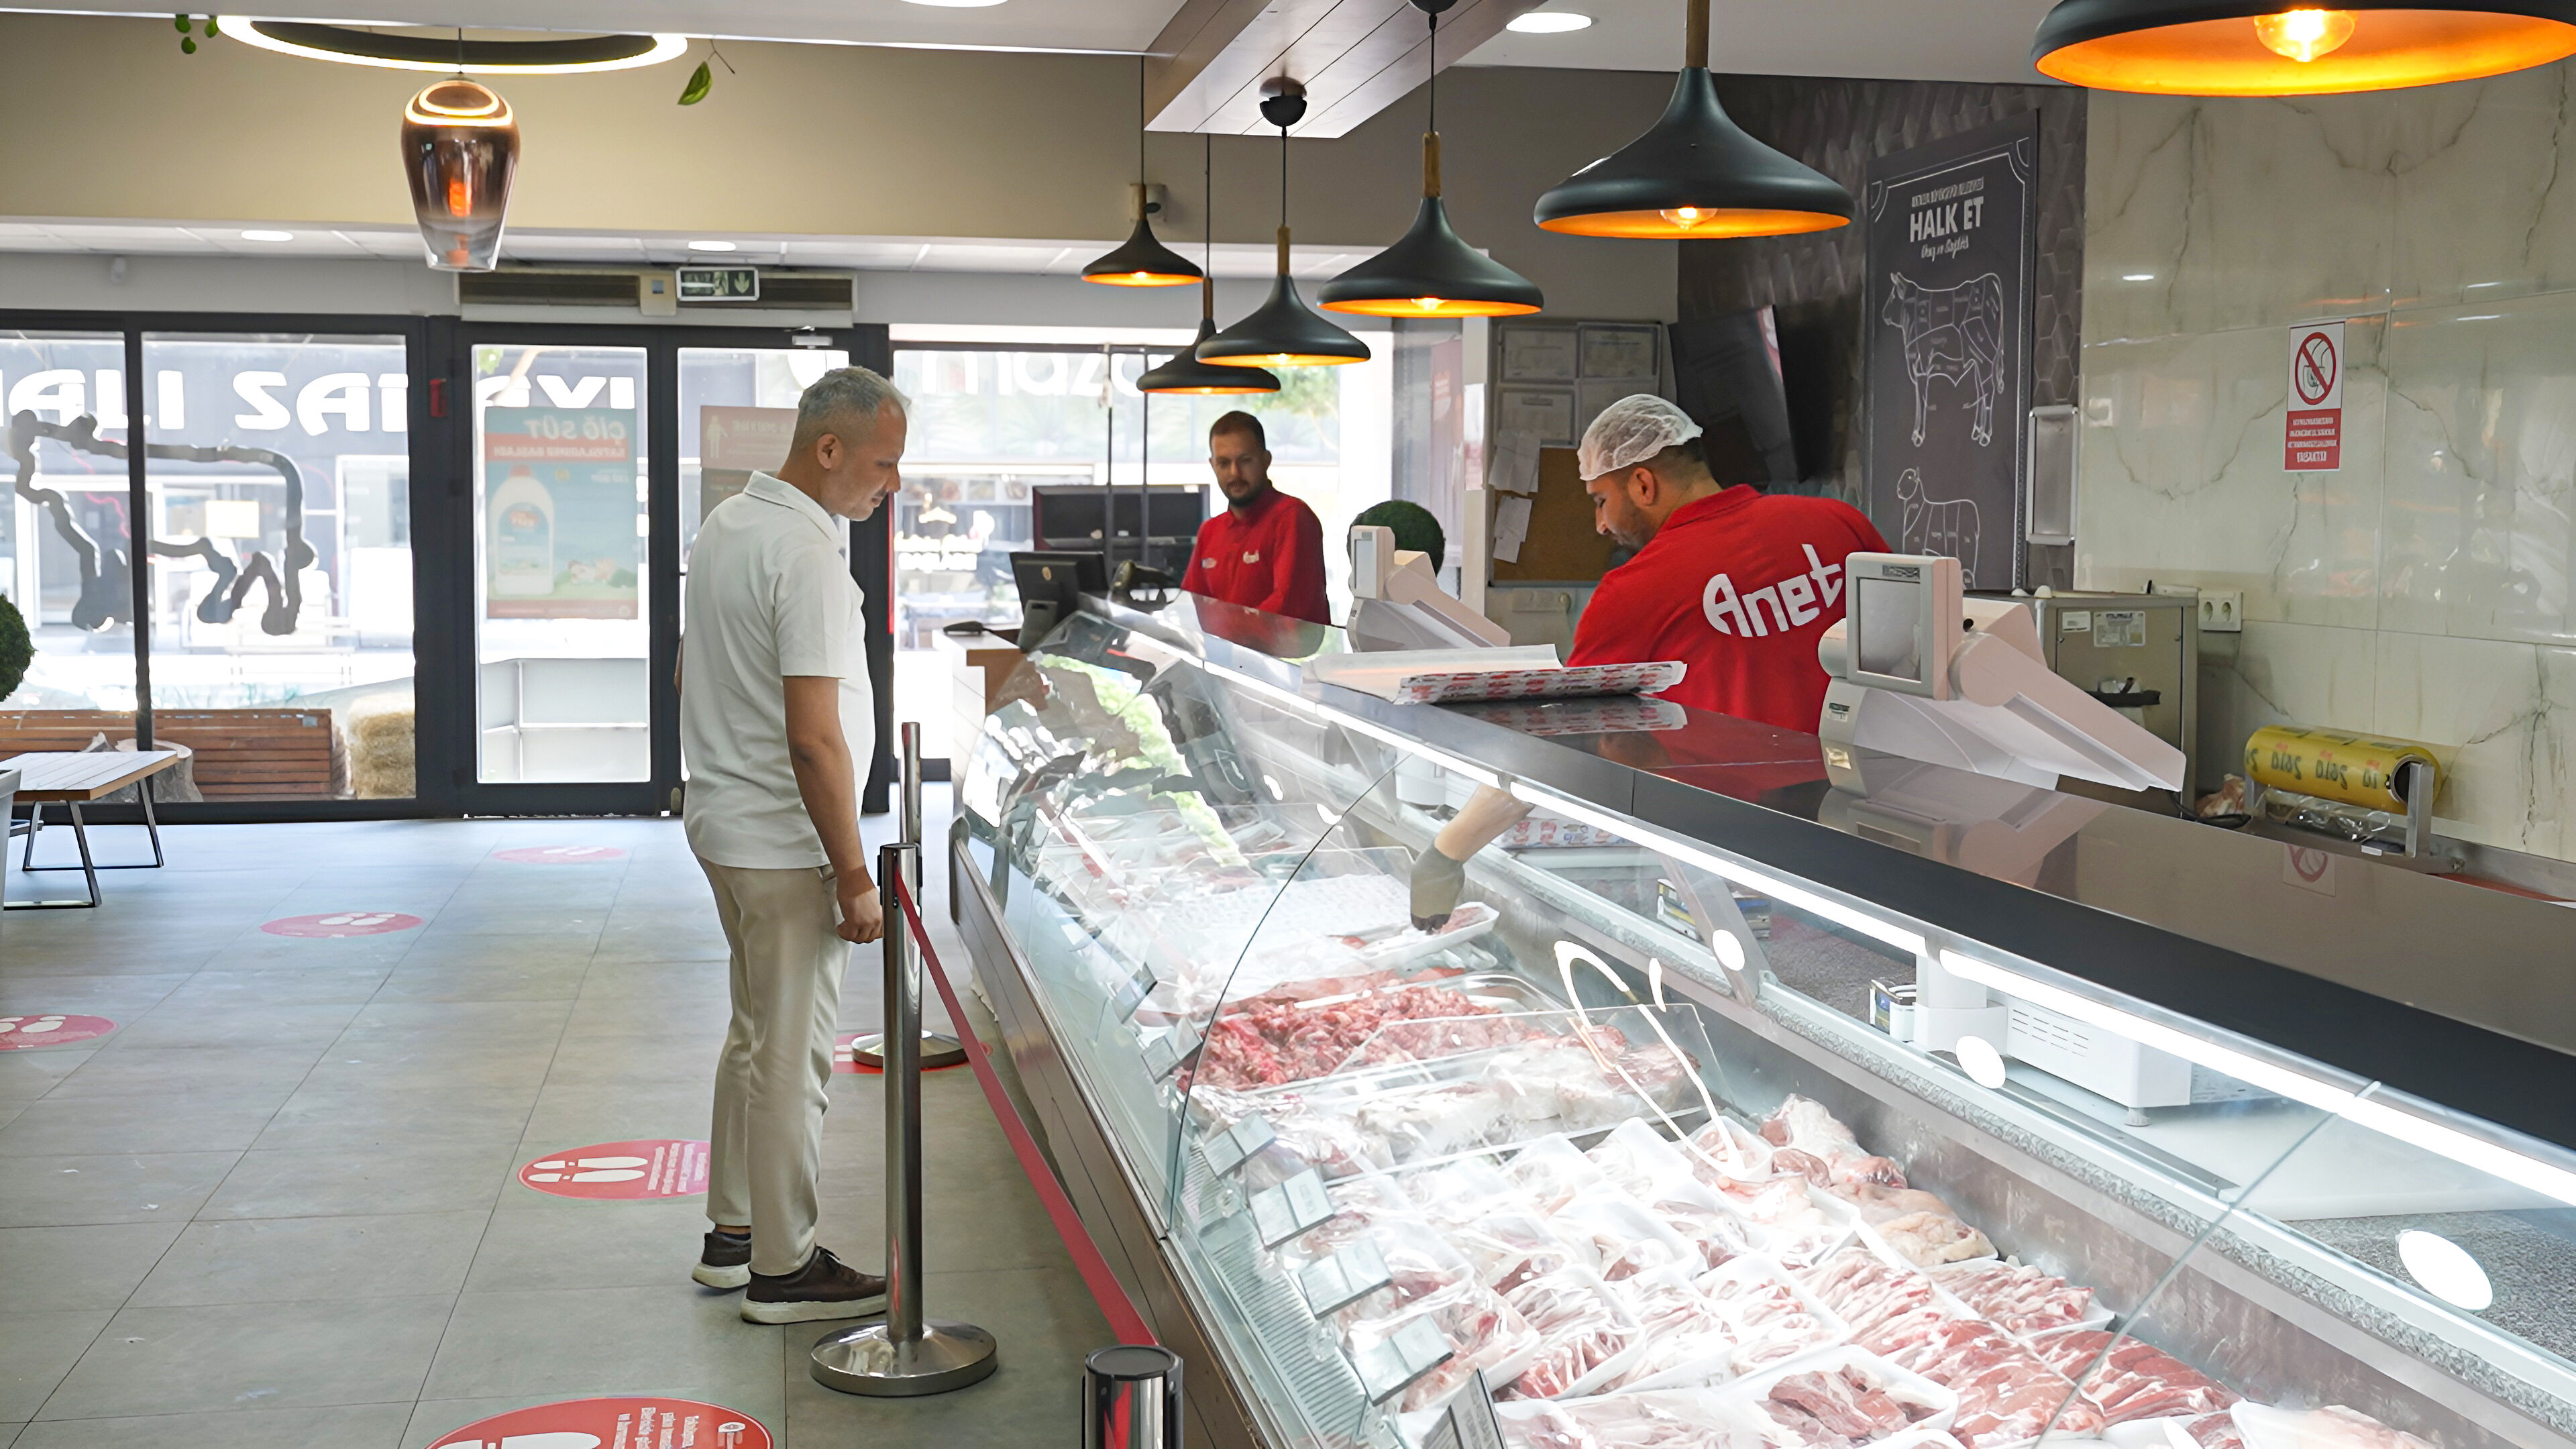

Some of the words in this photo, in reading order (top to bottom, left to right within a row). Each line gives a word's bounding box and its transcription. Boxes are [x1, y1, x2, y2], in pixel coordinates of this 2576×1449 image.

[1910, 203, 1958, 242] HALK
[1964, 196, 1984, 230] ET
[0, 369, 185, 430] ALI
[1703, 543, 1843, 637] Anet
